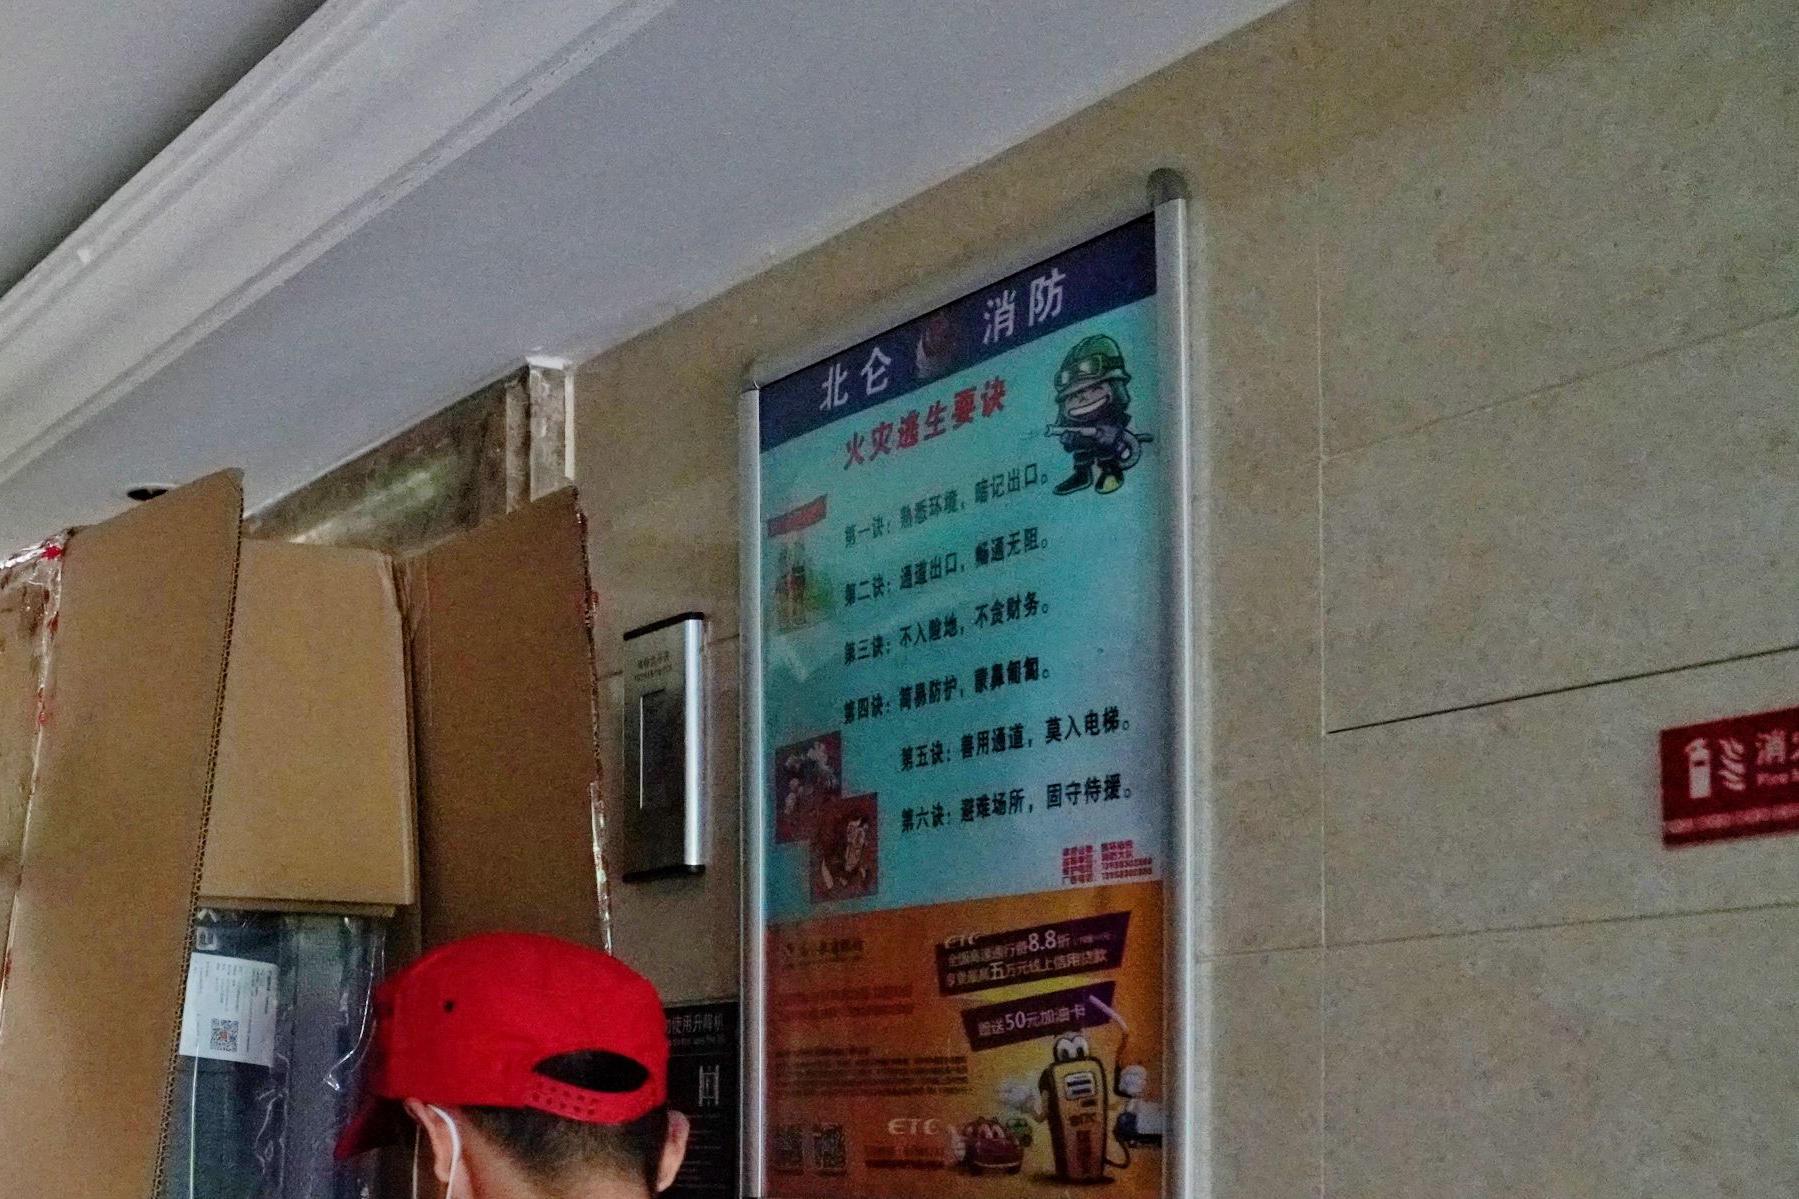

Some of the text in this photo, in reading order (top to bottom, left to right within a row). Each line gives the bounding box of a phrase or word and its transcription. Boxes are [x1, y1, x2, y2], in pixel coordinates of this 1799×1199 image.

[819, 267, 1066, 411] 北仑 消防
[843, 374, 1007, 470] 火灾逃生要诀
[888, 1117, 942, 1136] ETC
